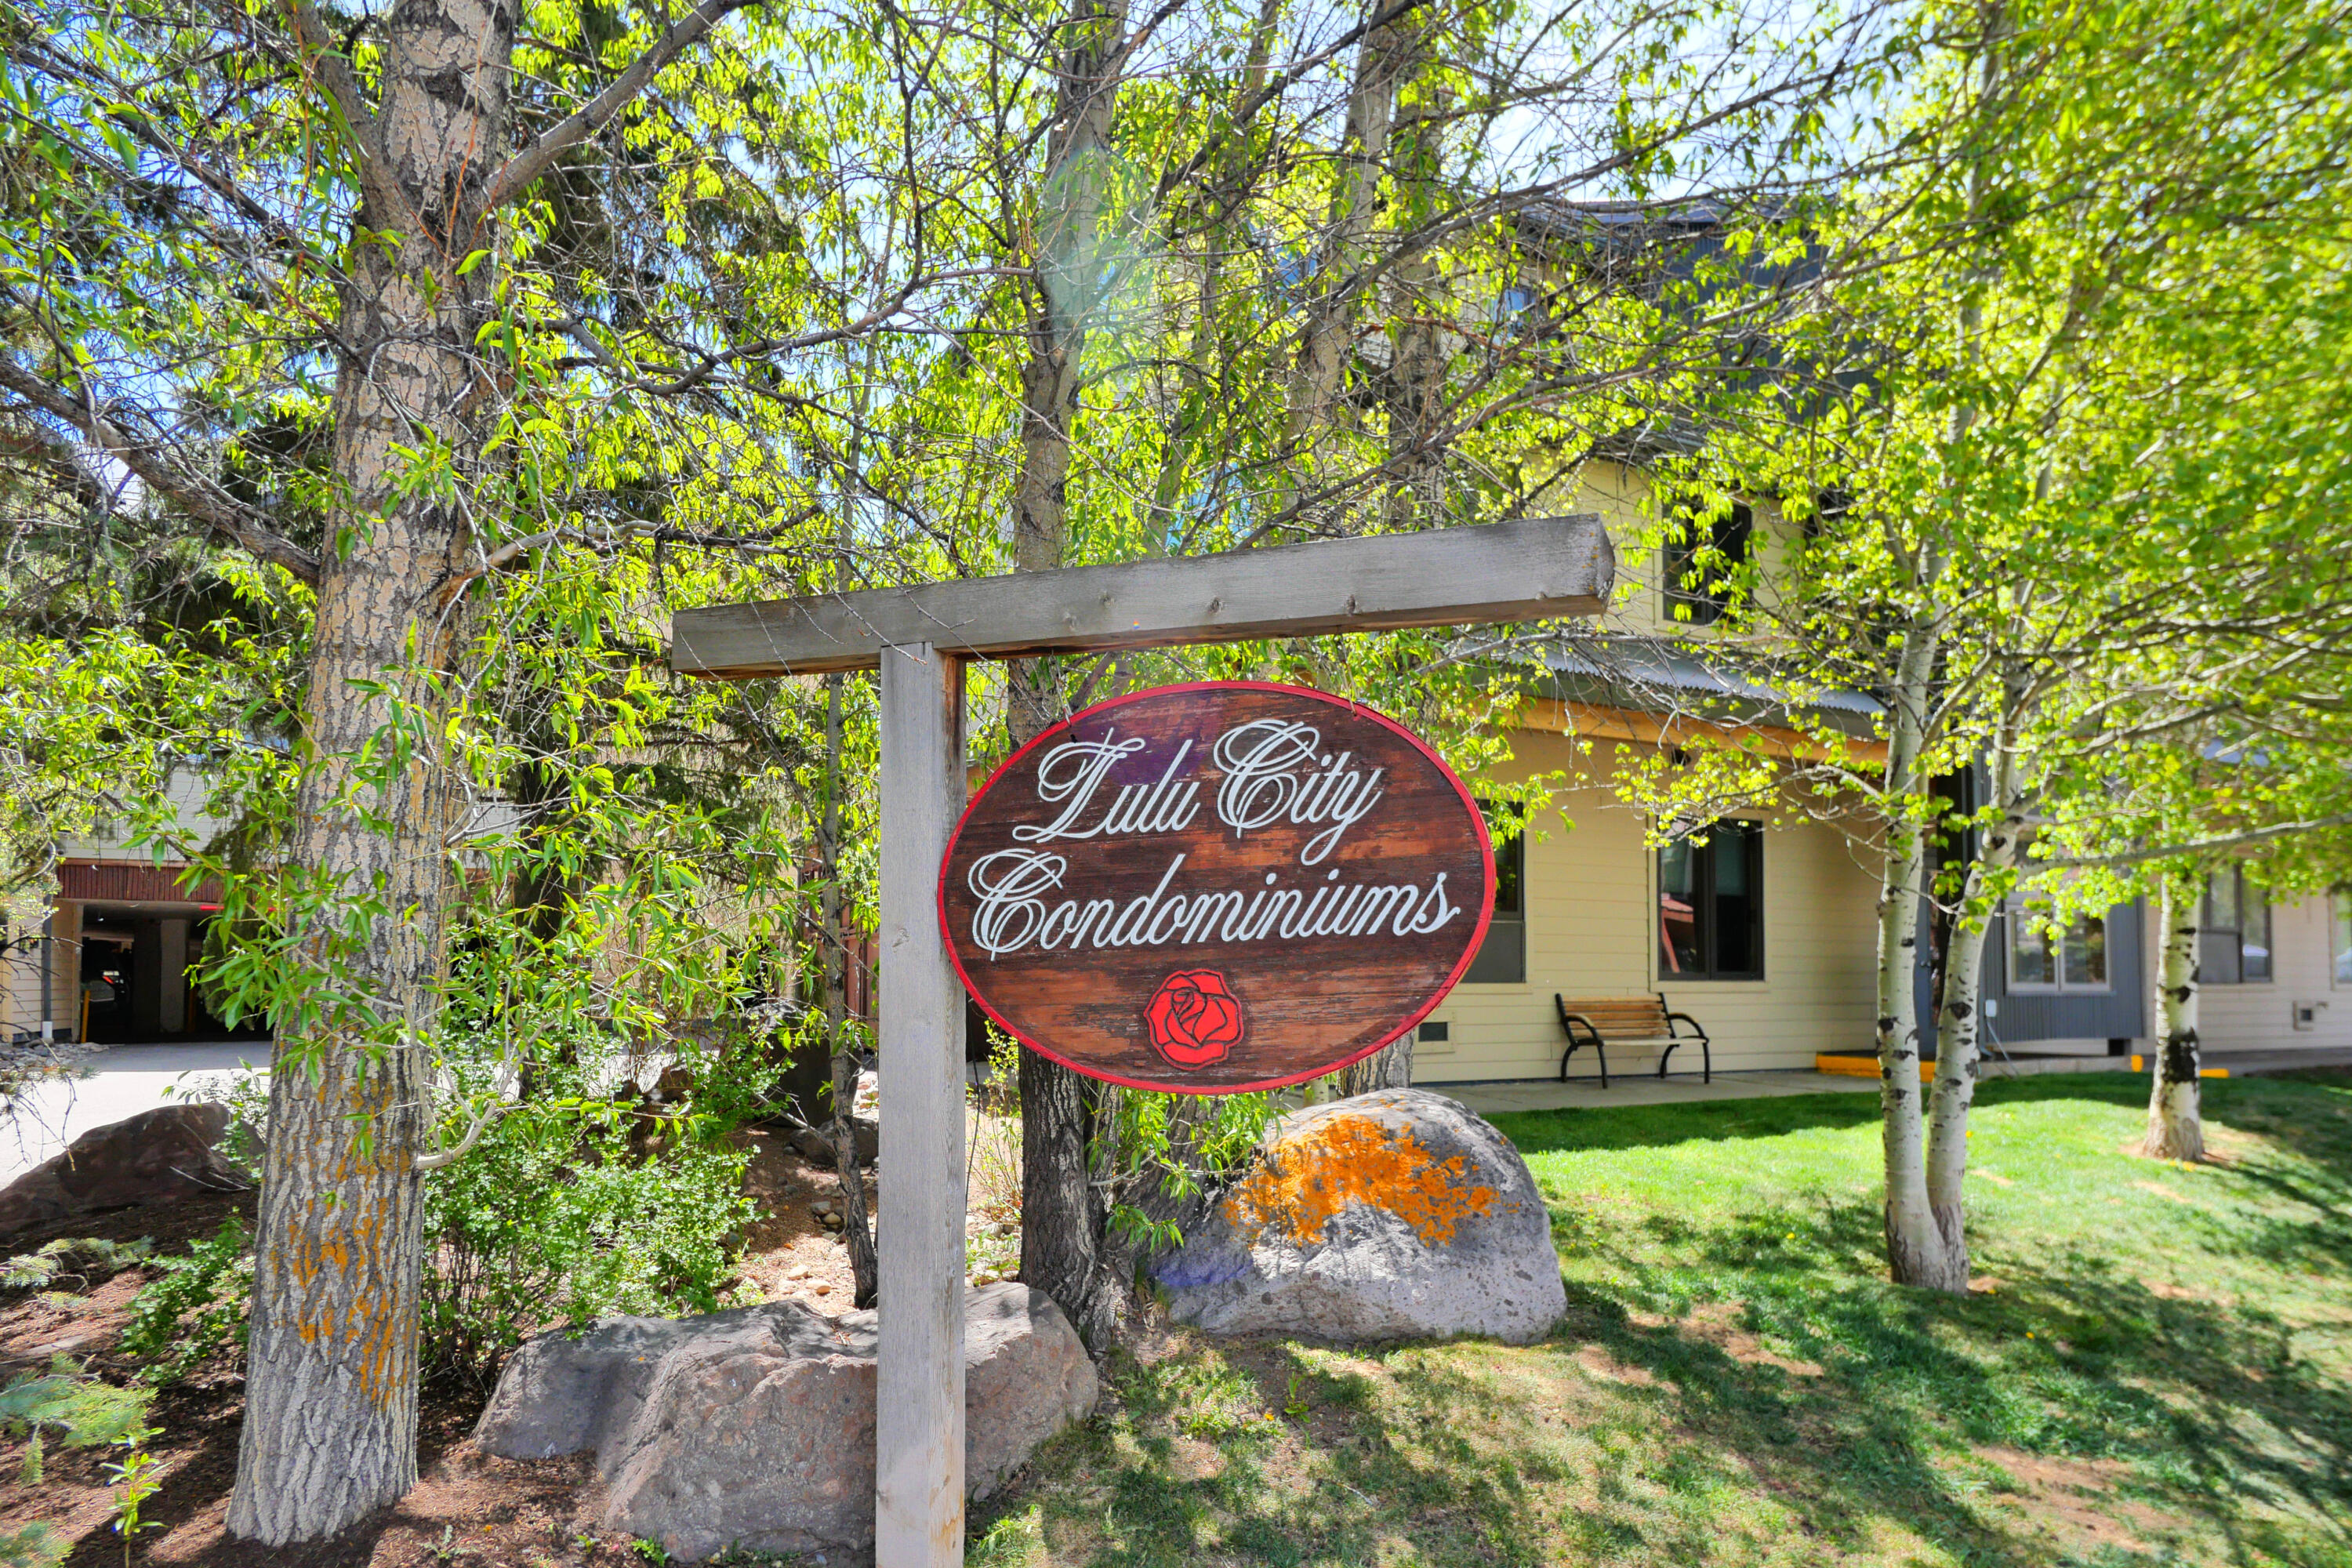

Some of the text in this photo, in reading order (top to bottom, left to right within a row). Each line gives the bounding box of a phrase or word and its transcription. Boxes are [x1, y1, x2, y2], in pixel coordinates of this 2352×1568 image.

[1012, 719, 1383, 866] Lulu City
[967, 848, 1461, 960] Condominiums
